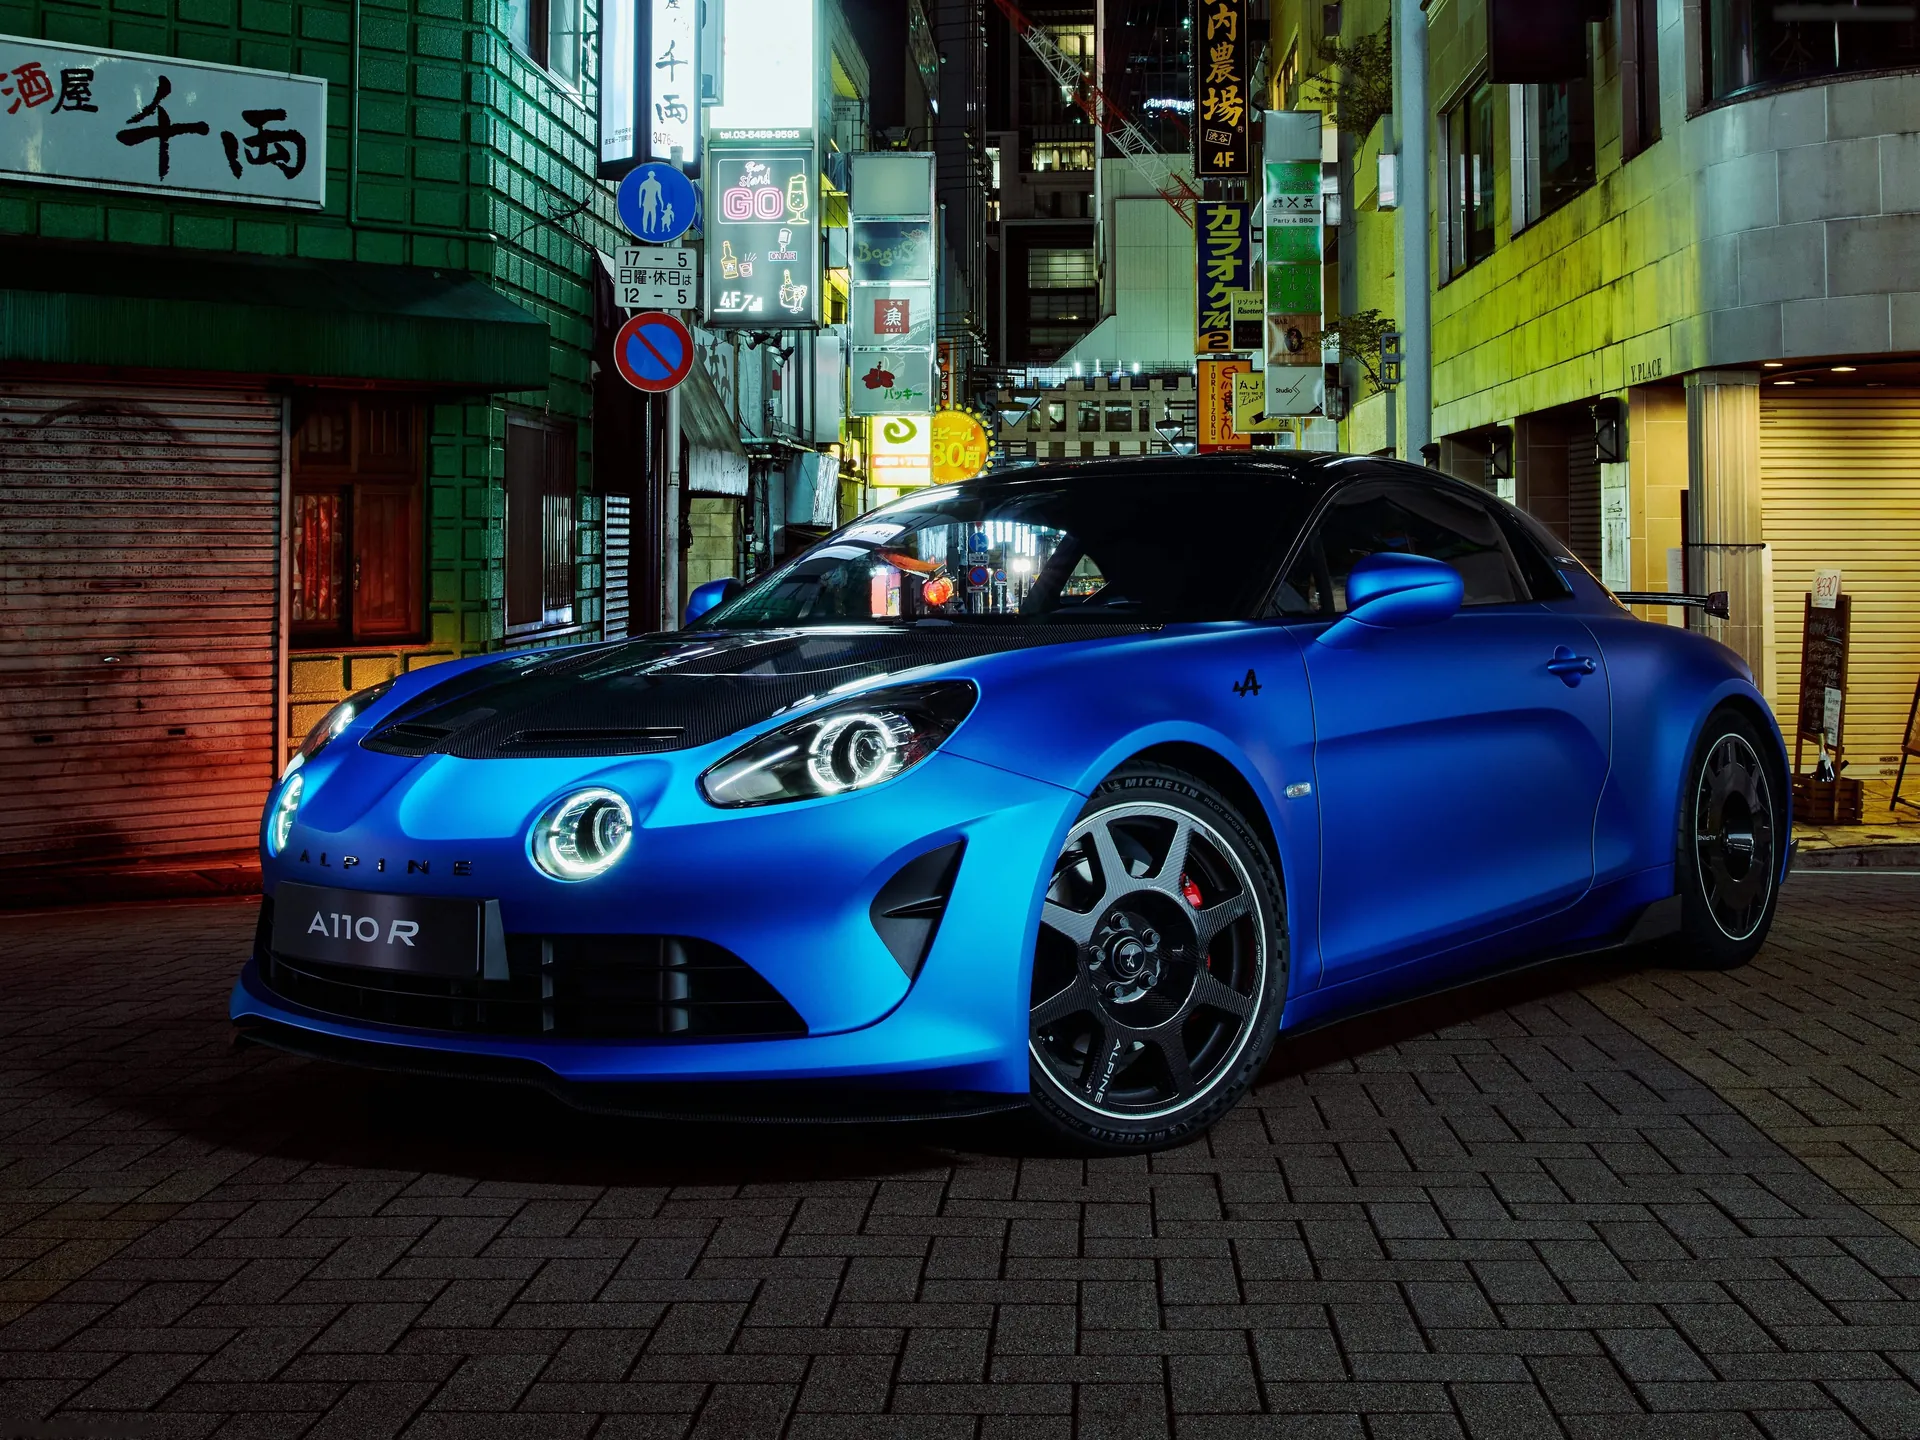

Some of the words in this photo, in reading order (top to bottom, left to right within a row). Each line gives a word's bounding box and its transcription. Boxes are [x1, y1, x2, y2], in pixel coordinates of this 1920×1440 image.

[1202, 0, 1243, 127] 内農場
[1213, 151, 1235, 168] 4F
[724, 187, 784, 220] GO
[625, 250, 640, 266] 17
[677, 252, 687, 268] 5
[770, 252, 781, 260] ON
[783, 252, 796, 260] AIR
[620, 269, 692, 286] 日曜・休日は
[624, 287, 639, 303] 12
[677, 289, 687, 305] 5
[720, 291, 741, 309] 4F
[1278, 418, 1290, 428] 2F
[1124, 776, 1200, 799] MICHELIN
[1203, 796, 1224, 814] PILOT
[1223, 812, 1245, 836] SPORT
[1243, 835, 1257, 852] CUP
[300, 849, 473, 877] ALPINE
[307, 911, 380, 943] A110
[387, 919, 420, 947] R
[1094, 1037, 1121, 1104] ALPINE
[1086, 1126, 1166, 1146] MICHELIN
